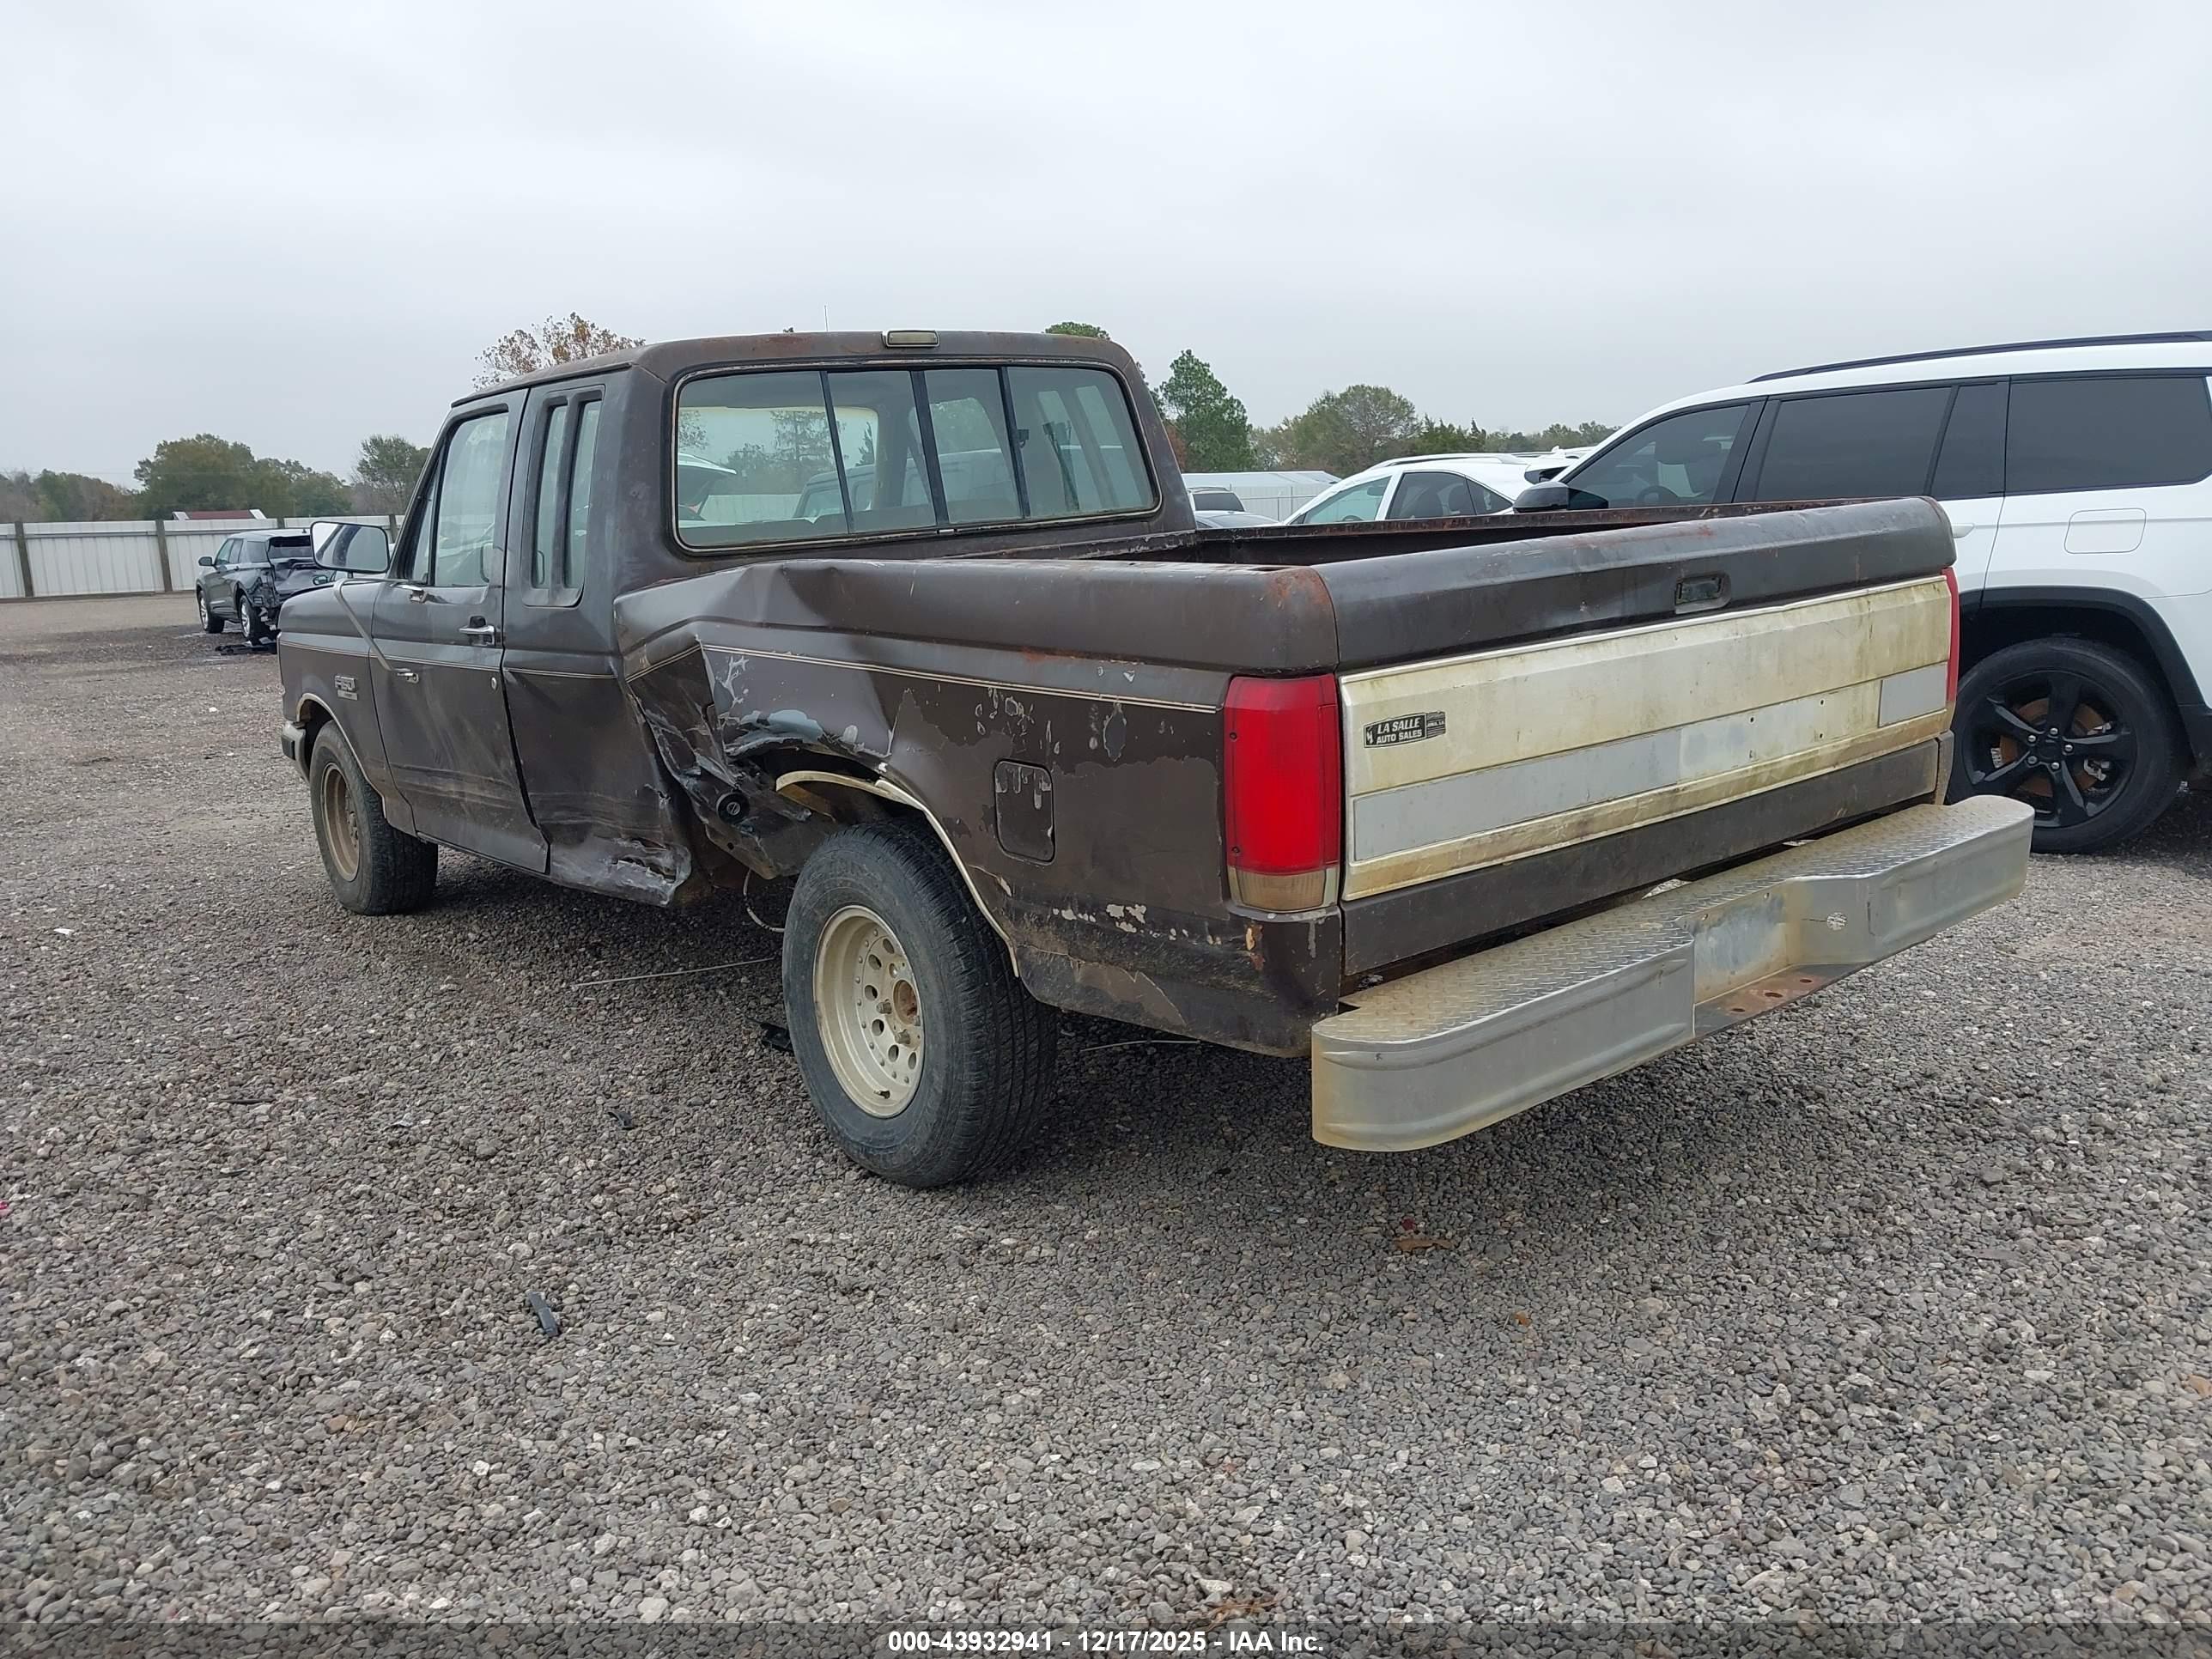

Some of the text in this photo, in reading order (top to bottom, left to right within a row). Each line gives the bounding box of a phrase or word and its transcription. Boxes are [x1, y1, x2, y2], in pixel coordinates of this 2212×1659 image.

[1377, 717, 1421, 734] LA SALLE
[1376, 729, 1423, 744] AUTO SALES
